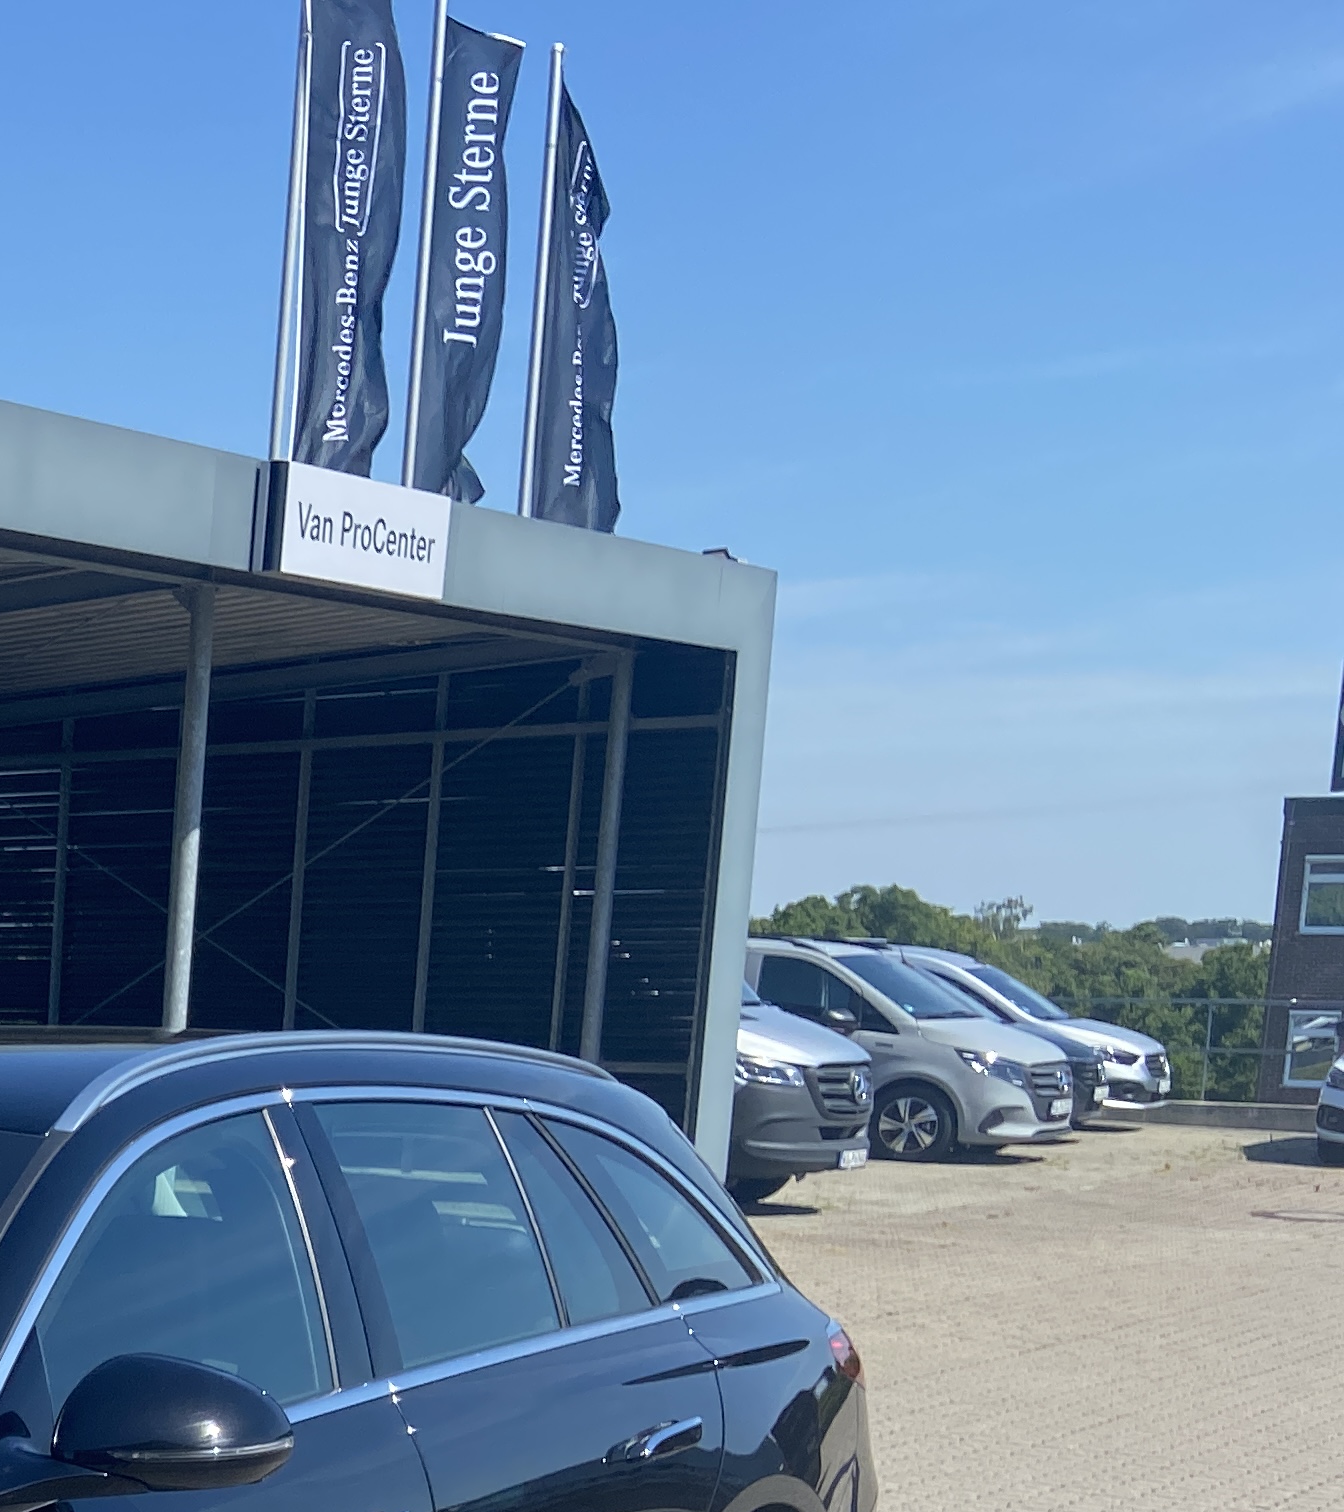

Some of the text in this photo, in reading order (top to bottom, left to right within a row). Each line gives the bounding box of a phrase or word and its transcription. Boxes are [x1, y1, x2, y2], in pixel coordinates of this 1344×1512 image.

[322, 47, 375, 443] Mercedes-Benz Junge Sterne
[443, 71, 500, 348] Junge Sterne
[297, 501, 436, 564] Van ProCenter
